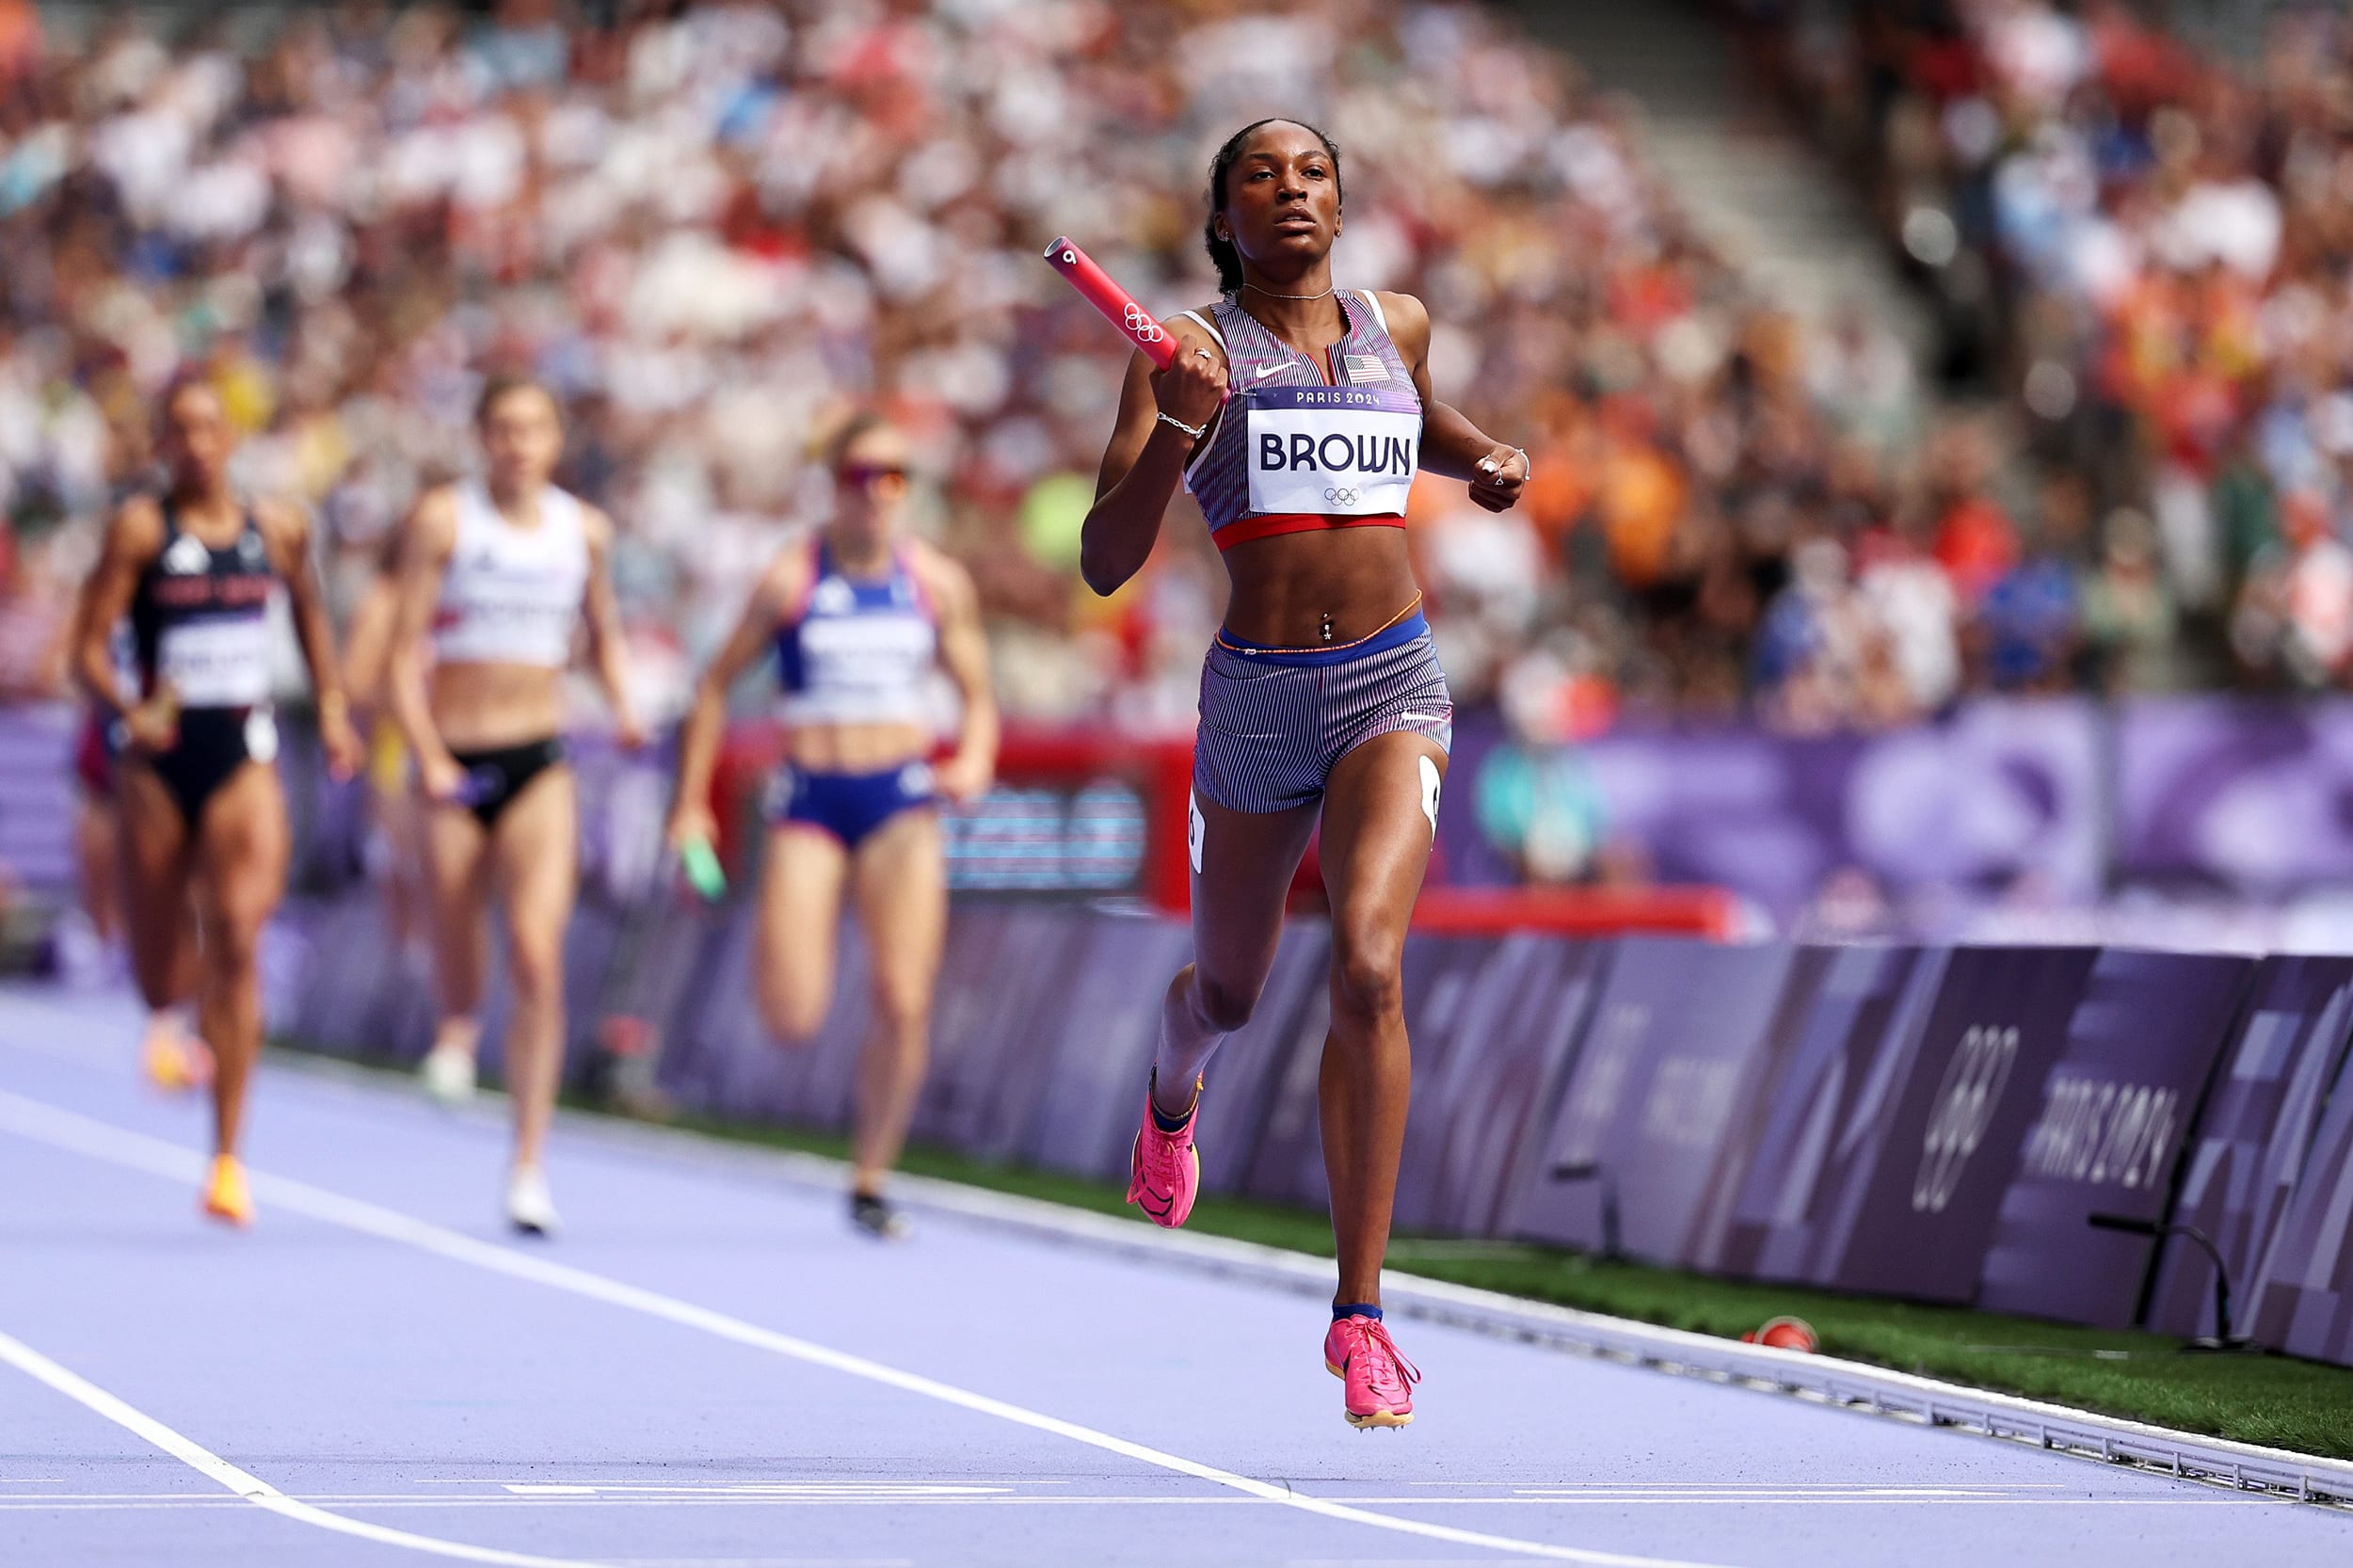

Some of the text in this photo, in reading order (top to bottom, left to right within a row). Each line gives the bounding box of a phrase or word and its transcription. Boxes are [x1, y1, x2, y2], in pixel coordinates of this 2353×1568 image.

[1296, 392, 1380, 405] PARIS 2024
[1260, 433, 1411, 475] BROWN
